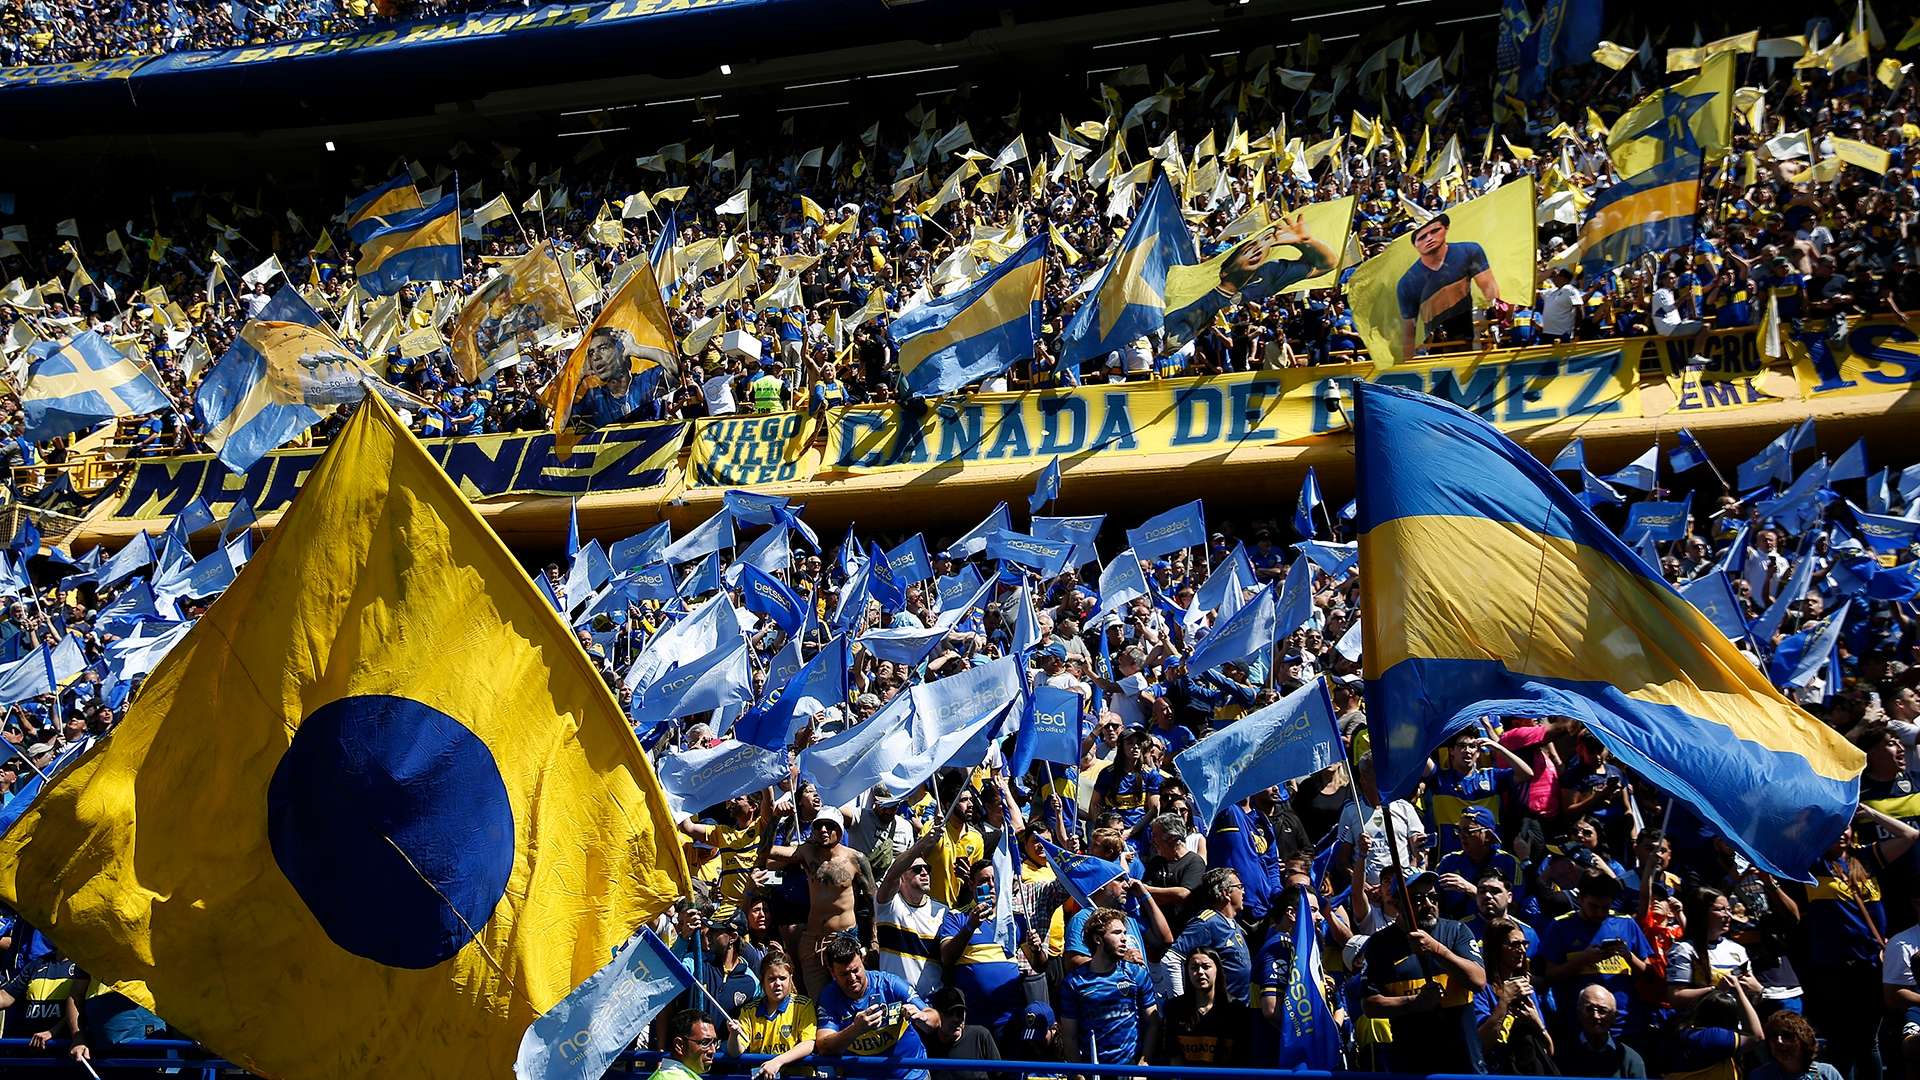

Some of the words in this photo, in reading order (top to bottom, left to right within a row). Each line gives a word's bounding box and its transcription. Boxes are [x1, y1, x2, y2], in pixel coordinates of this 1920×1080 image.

[230, 31, 397, 63] BARRIO
[400, 7, 590, 43] FAMILIA
[1169, 380, 1280, 446] DE
[1311, 350, 1624, 433] GMEZ
[704, 414, 803, 441] DIEGO
[709, 439, 785, 465] PILU
[113, 422, 687, 517] MARNEZ
[694, 461, 797, 487] MATEO
[1288, 956, 1313, 1034] sson
